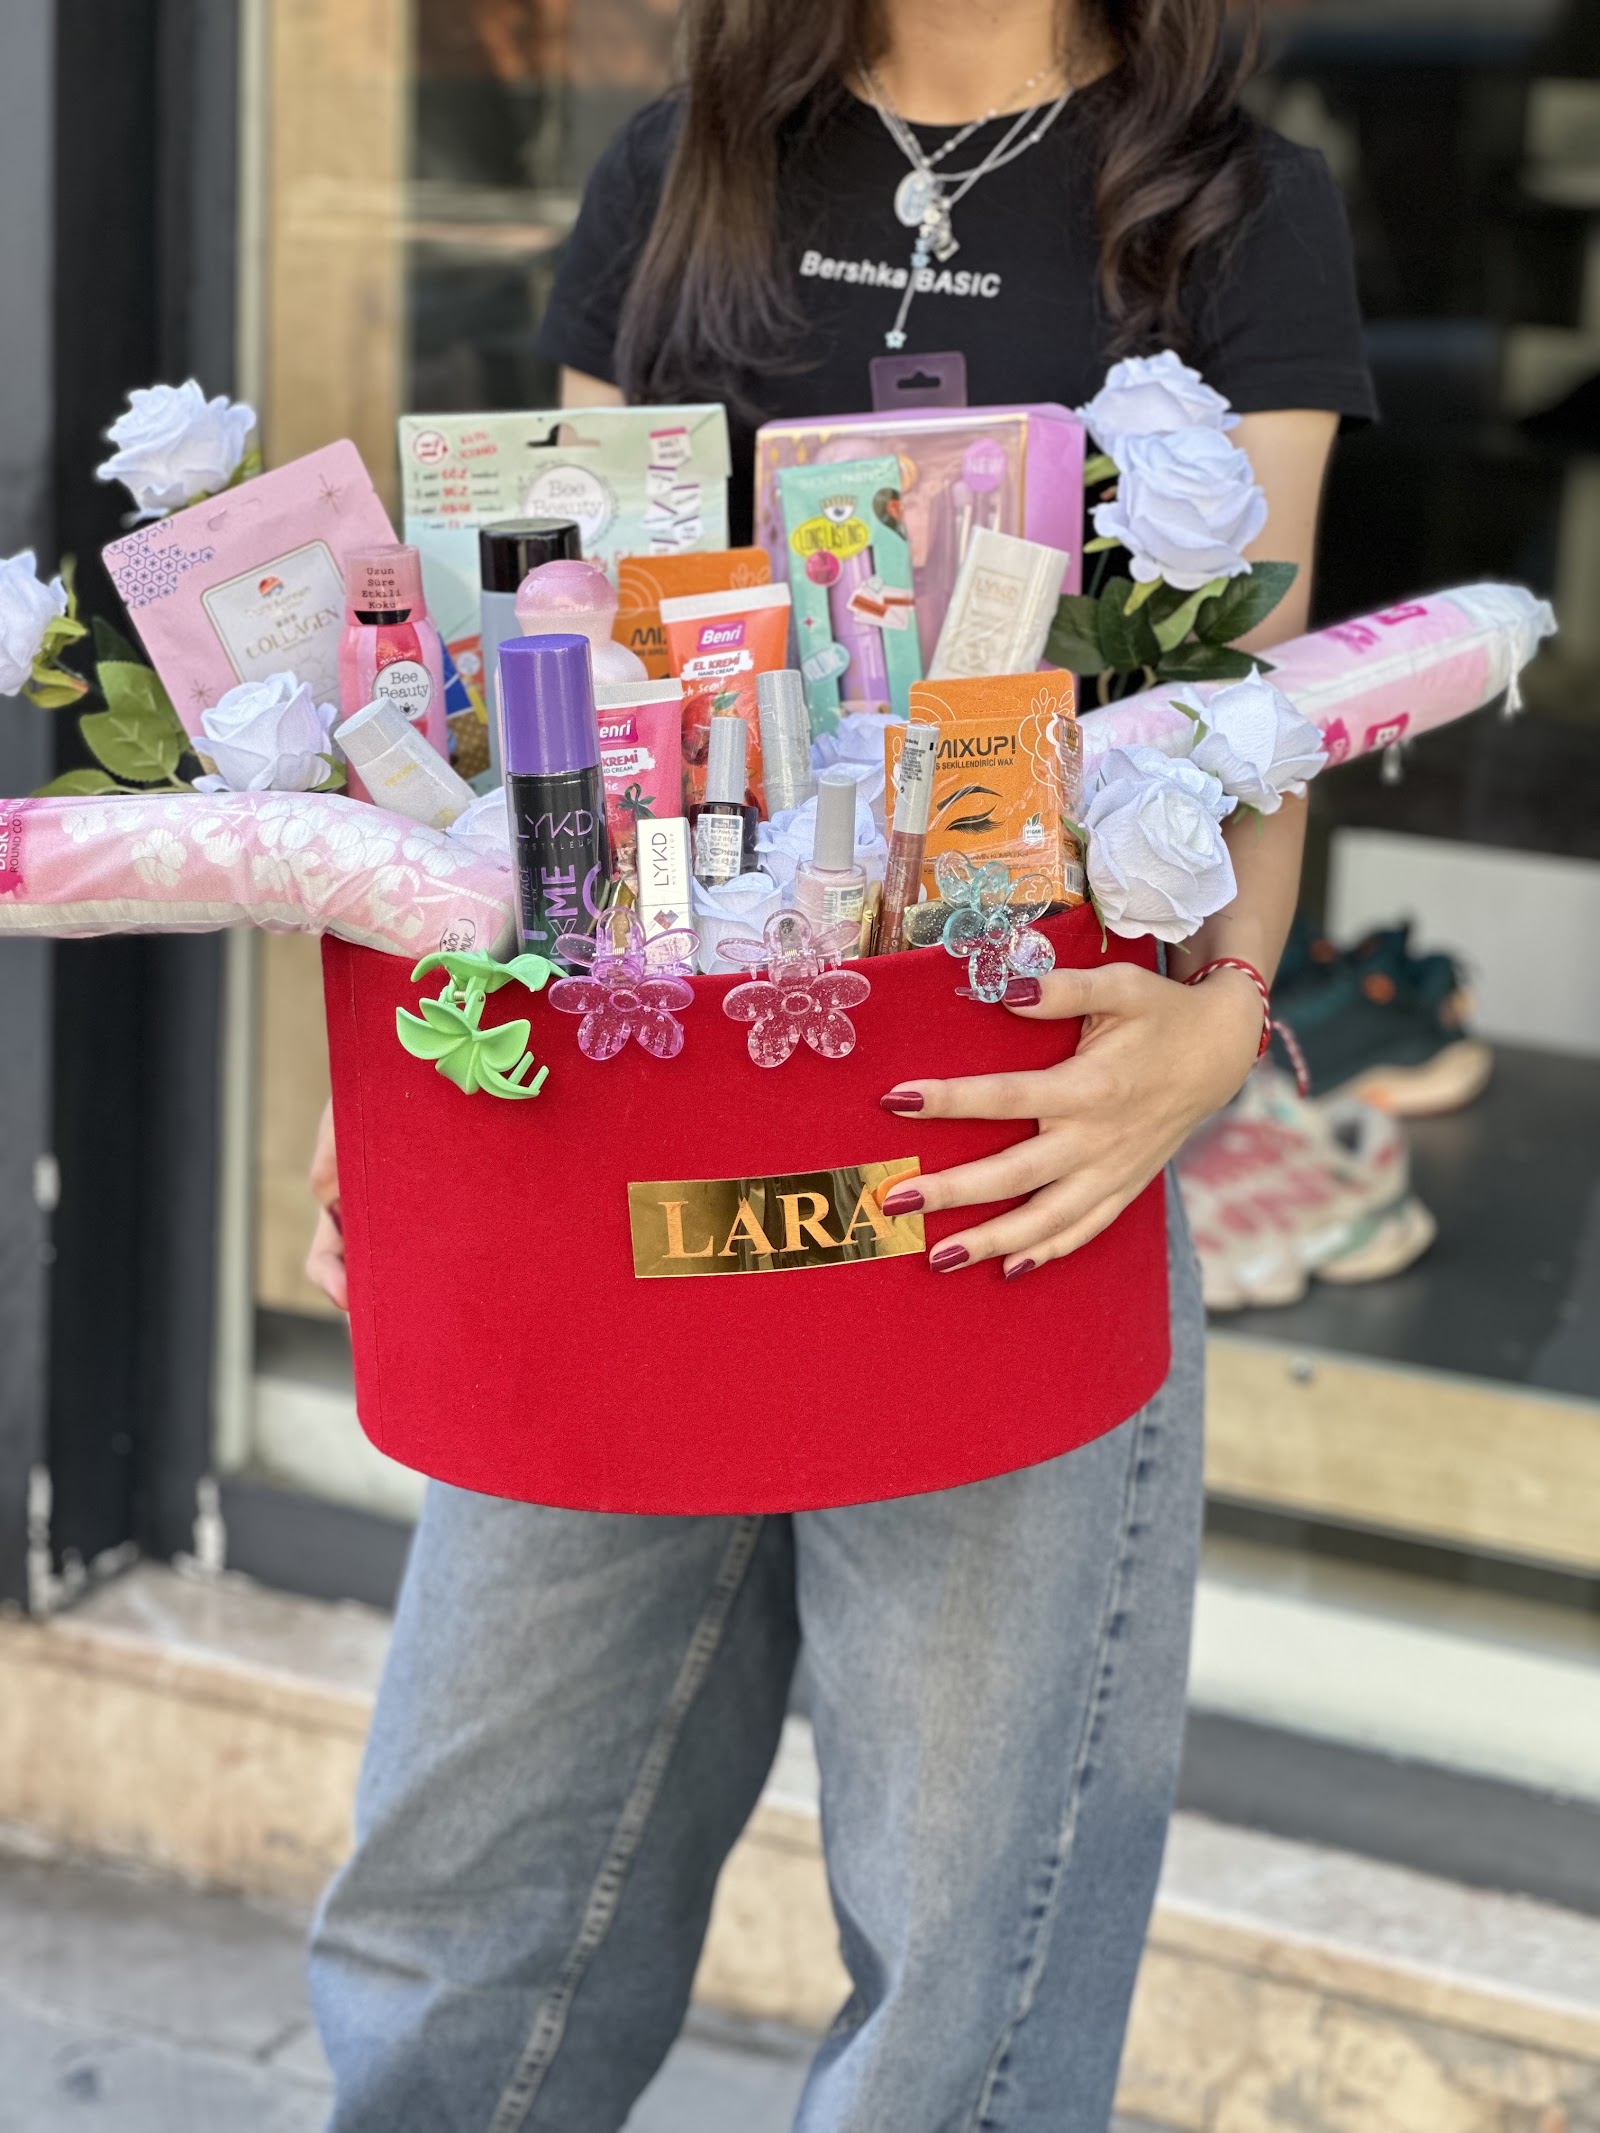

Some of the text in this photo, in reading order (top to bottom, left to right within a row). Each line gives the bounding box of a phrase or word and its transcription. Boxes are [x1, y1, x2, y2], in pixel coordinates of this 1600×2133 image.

[800, 250, 1001, 297] Bershka BASIC
[366, 567, 394, 575] Uzun
[368, 577, 395, 586] Süre
[362, 589, 401, 597] Etkili
[369, 601, 396, 609] Koku
[245, 607, 340, 660] COLLAGEN
[701, 624, 742, 645] Benri
[693, 652, 741, 671] EL KREMİ
[390, 672, 418, 684] Bee
[379, 684, 429, 698] Beauty
[599, 720, 631, 738] enri
[602, 750, 638, 767] KREMİ
[997, 758, 1013, 766] WAX
[612, 765, 633, 773] CREAM
[517, 809, 593, 838] LYKD
[10, 836, 22, 873] ROUND
[652, 832, 669, 886] LYKD
[658, 1184, 893, 1258] LARA
